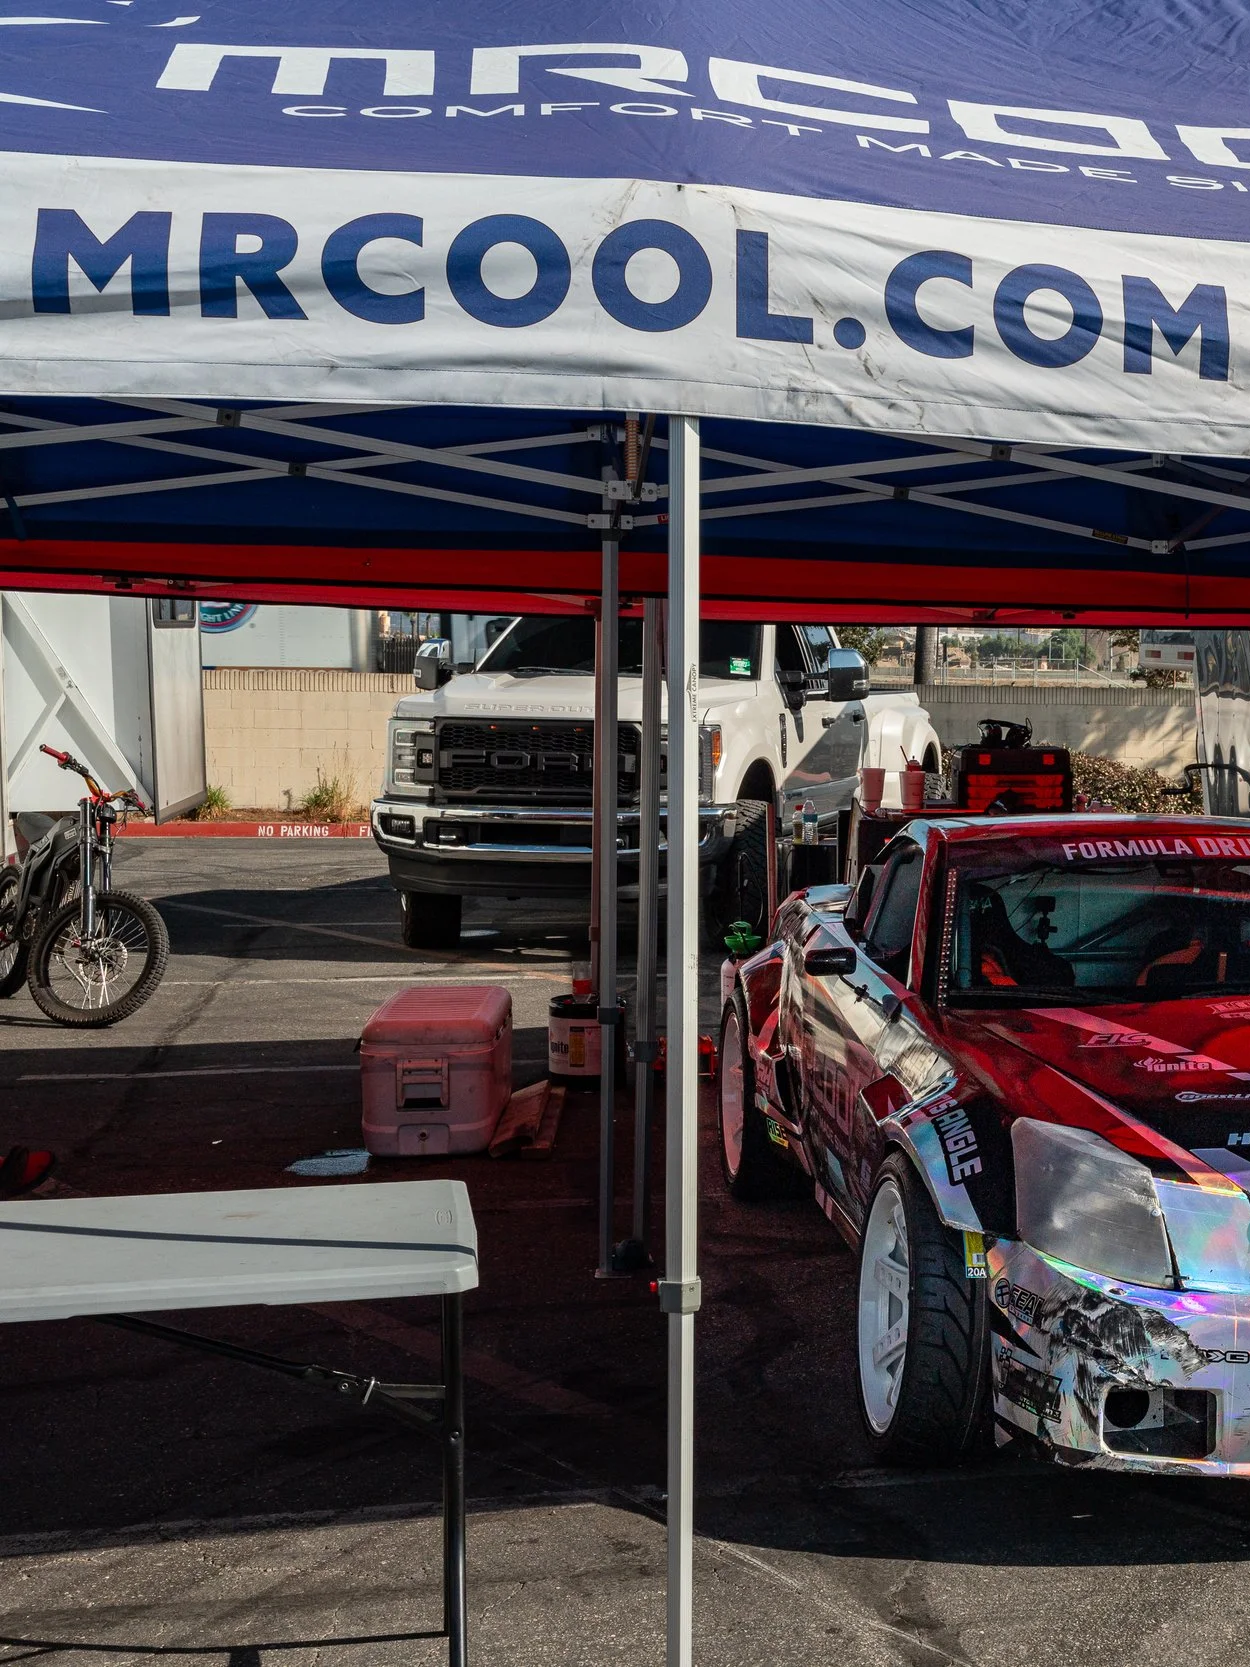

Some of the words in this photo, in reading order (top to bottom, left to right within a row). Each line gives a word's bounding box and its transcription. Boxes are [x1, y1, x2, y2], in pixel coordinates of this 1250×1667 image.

[282, 101, 822, 137] COMFORT
[858, 134, 1138, 184] MADE
[31, 207, 1231, 382] MRCOOL.COM
[464, 703, 544, 712] SUPER
[549, 705, 595, 713] DUT
[258, 825, 274, 837] NO
[280, 825, 330, 837] PARKING
[1061, 838, 1194, 861] FORMULA
[935, 1108, 983, 1182] ANGLE
